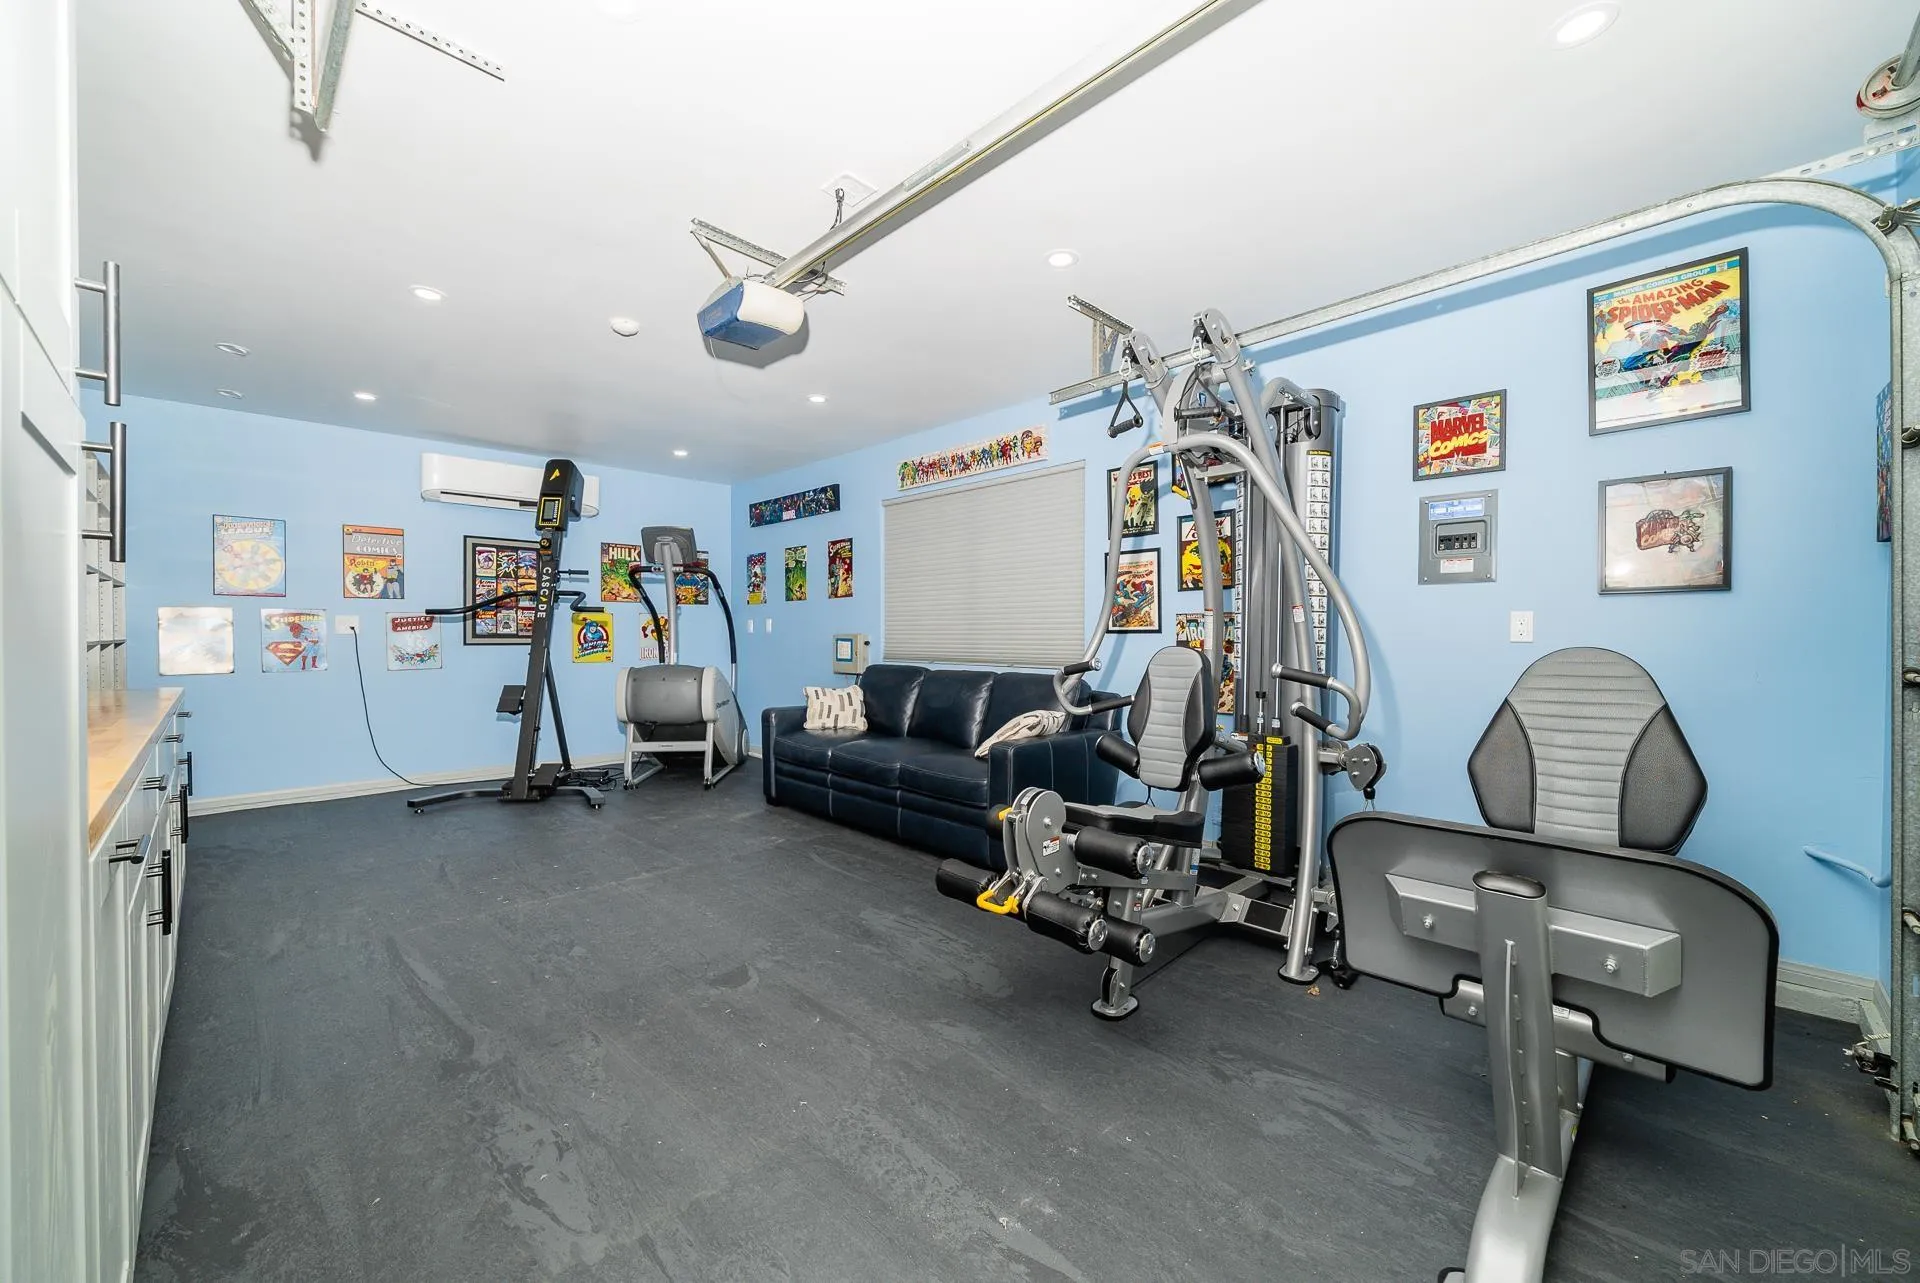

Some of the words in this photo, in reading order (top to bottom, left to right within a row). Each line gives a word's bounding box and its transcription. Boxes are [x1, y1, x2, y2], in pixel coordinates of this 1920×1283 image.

[1632, 278, 1704, 305] AMAZING
[1646, 276, 1679, 289] COMICS
[1681, 267, 1711, 281] GROUP
[1606, 280, 1731, 324] SPIDER-MAN
[1430, 412, 1488, 443] MARVEL
[1428, 429, 1493, 458] COMICS
[1138, 469, 1153, 480] BEST
[608, 546, 641, 562] HULK
